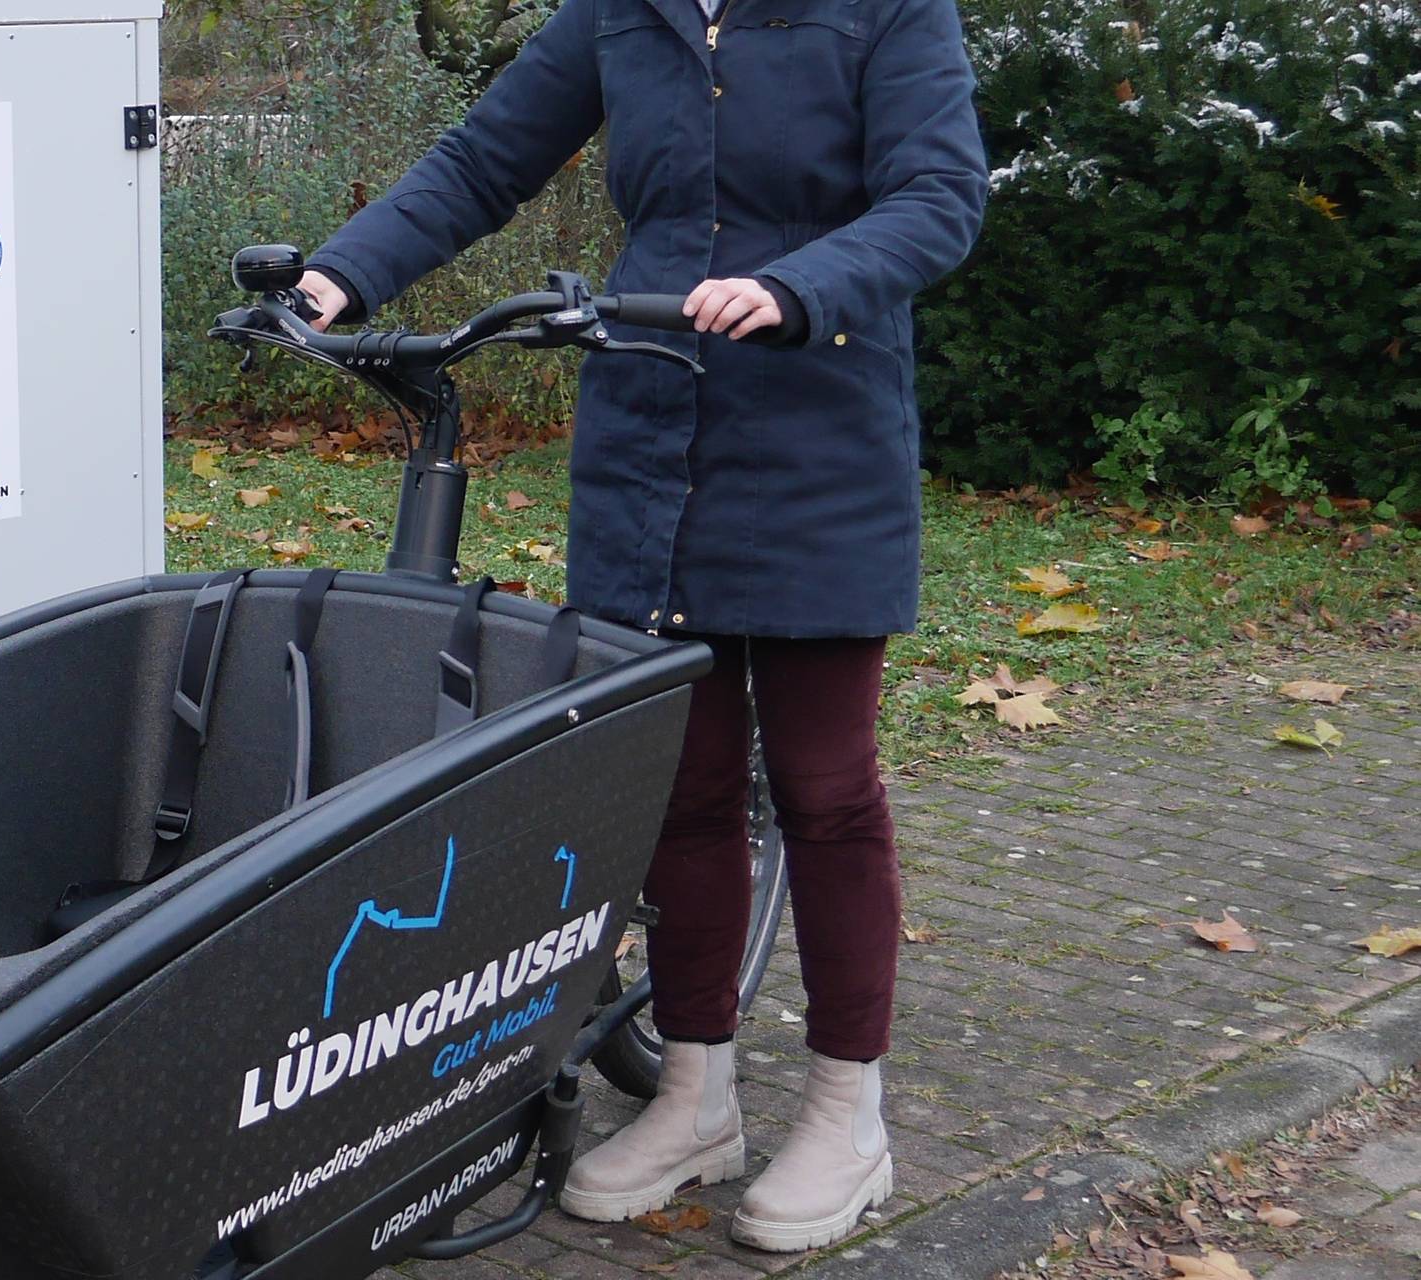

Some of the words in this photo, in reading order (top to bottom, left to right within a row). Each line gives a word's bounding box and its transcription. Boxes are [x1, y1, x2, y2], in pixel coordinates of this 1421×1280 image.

[238, 902, 610, 1129] LÜDINGHAUSEN
[432, 1030, 482, 1079] Gut
[483, 981, 559, 1051] Mobil.
[371, 1183, 446, 1251] URBAN
[444, 1133, 520, 1203] ARROW
